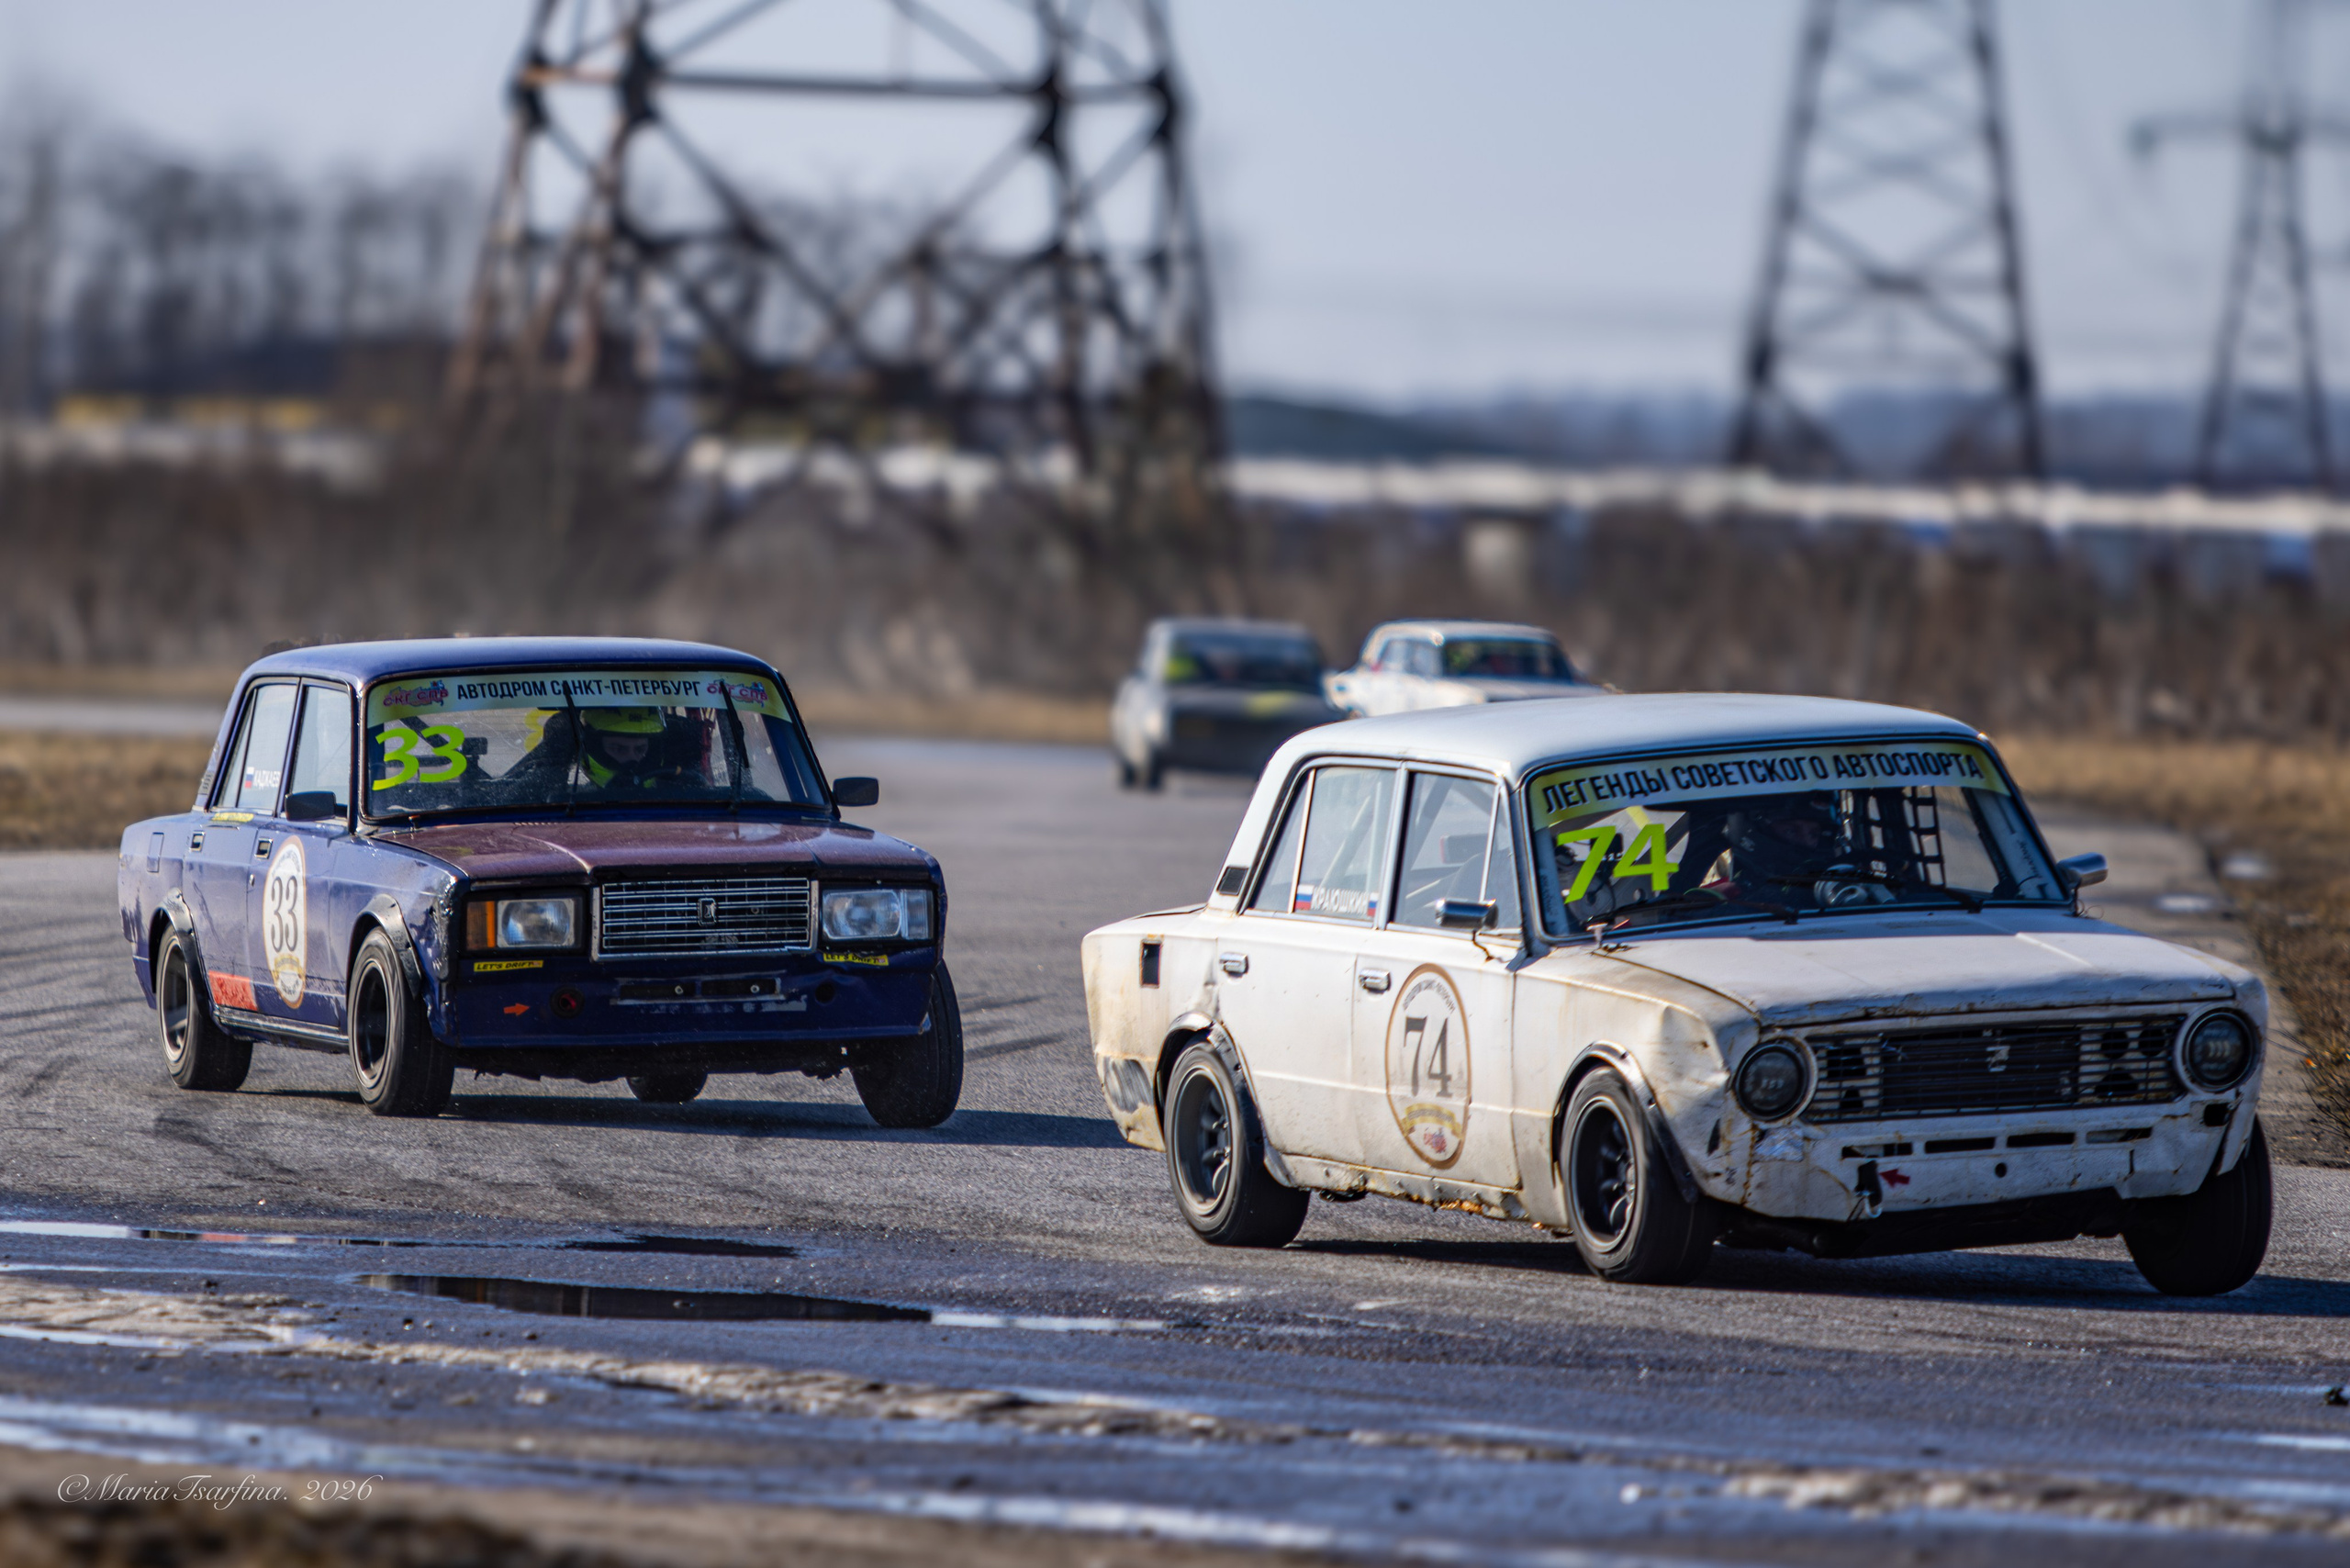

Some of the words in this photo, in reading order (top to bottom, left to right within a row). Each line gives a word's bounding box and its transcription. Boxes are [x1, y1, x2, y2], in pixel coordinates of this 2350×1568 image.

[457, 679, 548, 700] АВТОДРОМ
[550, 678, 700, 697] САНКТ-ПЕТЕРБУРГ
[372, 724, 467, 790] 33
[1542, 767, 1671, 814] ЛЕГЕНДЫ
[1671, 755, 1830, 790] СОВЕТСКОГО
[1833, 752, 1985, 779] АВТОСПОРТА
[1556, 823, 1680, 904] 74
[271, 876, 297, 952] 33
[505, 960, 532, 969] DRIFT
[1403, 1015, 1453, 1098] 74
